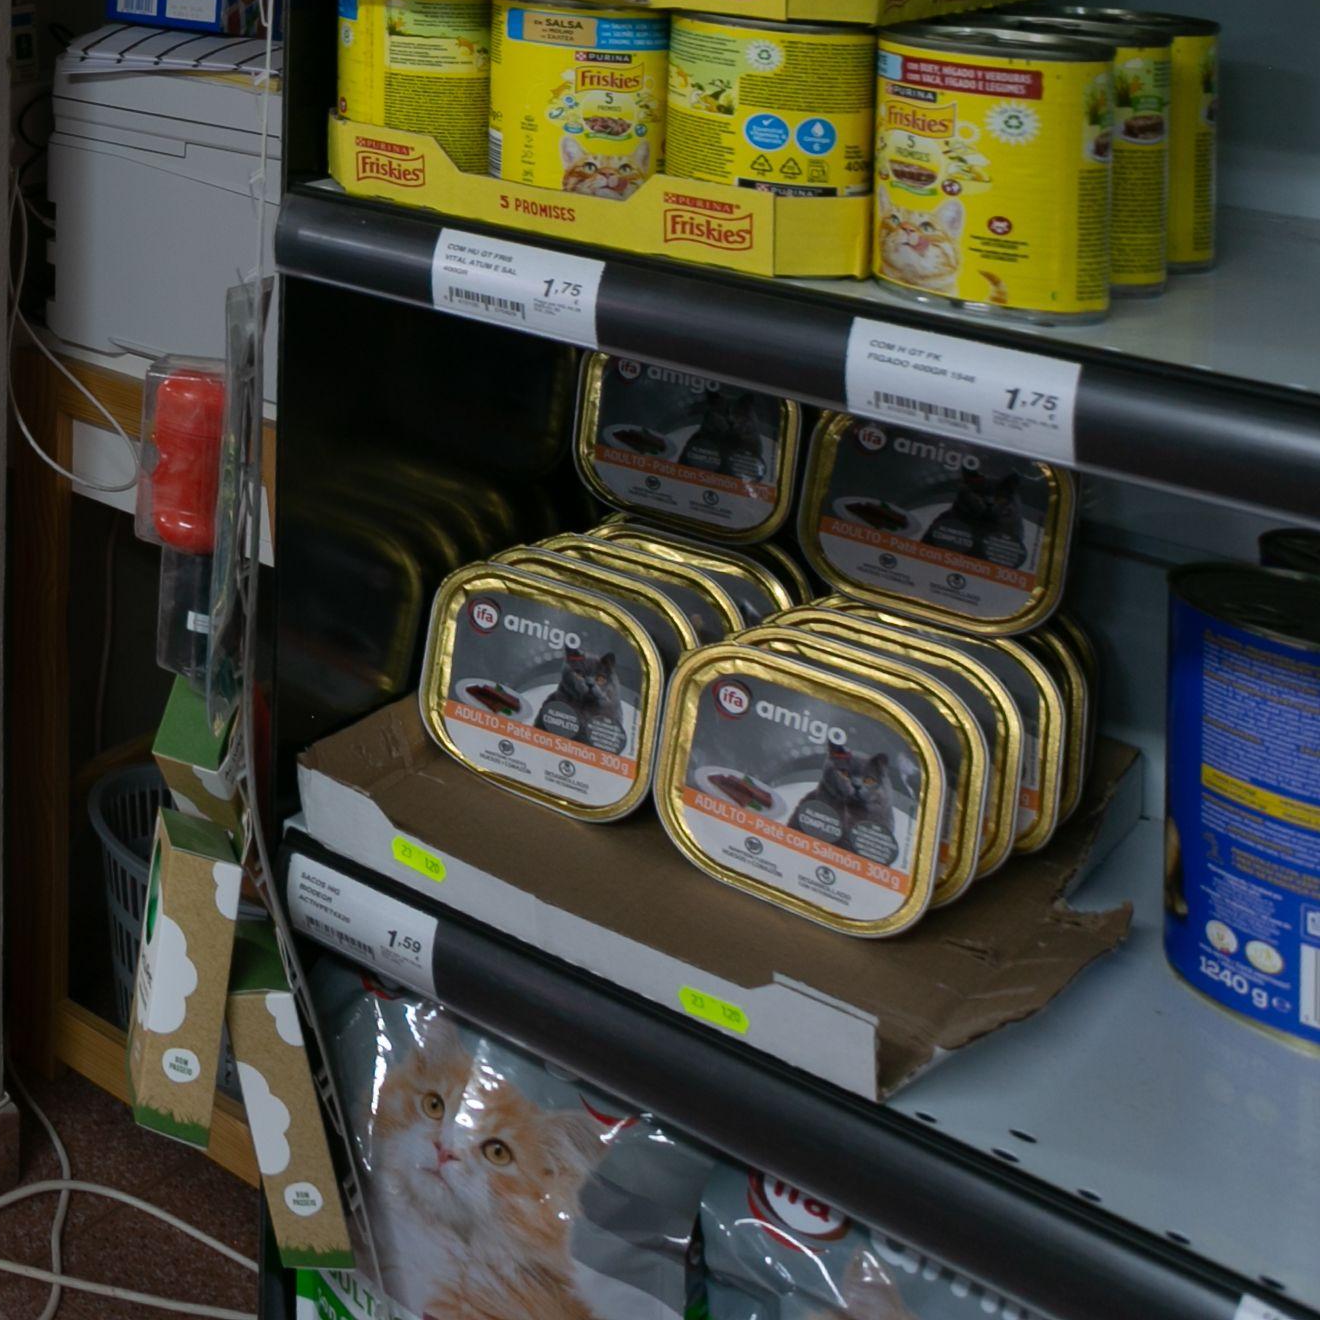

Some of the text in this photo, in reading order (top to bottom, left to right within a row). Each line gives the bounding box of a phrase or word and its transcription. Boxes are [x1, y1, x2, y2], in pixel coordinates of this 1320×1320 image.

[545, 17, 584, 30] SALSA
[500, 194, 577, 223] 5 PROMISES
[543, 279, 583, 297] 1,75
[1005, 388, 1059, 411] 1,75
[893, 433, 980, 471] amigo
[476, 607, 494, 623] ifa
[504, 614, 581, 649] amigo
[723, 689, 743, 709] ifa
[454, 705, 500, 729] ADULTO
[533, 731, 553, 747] con
[554, 737, 596, 761] Salmón
[756, 700, 847, 745] amigo
[388, 930, 421, 952] 1,59
[1199, 954, 1250, 999] 1240
